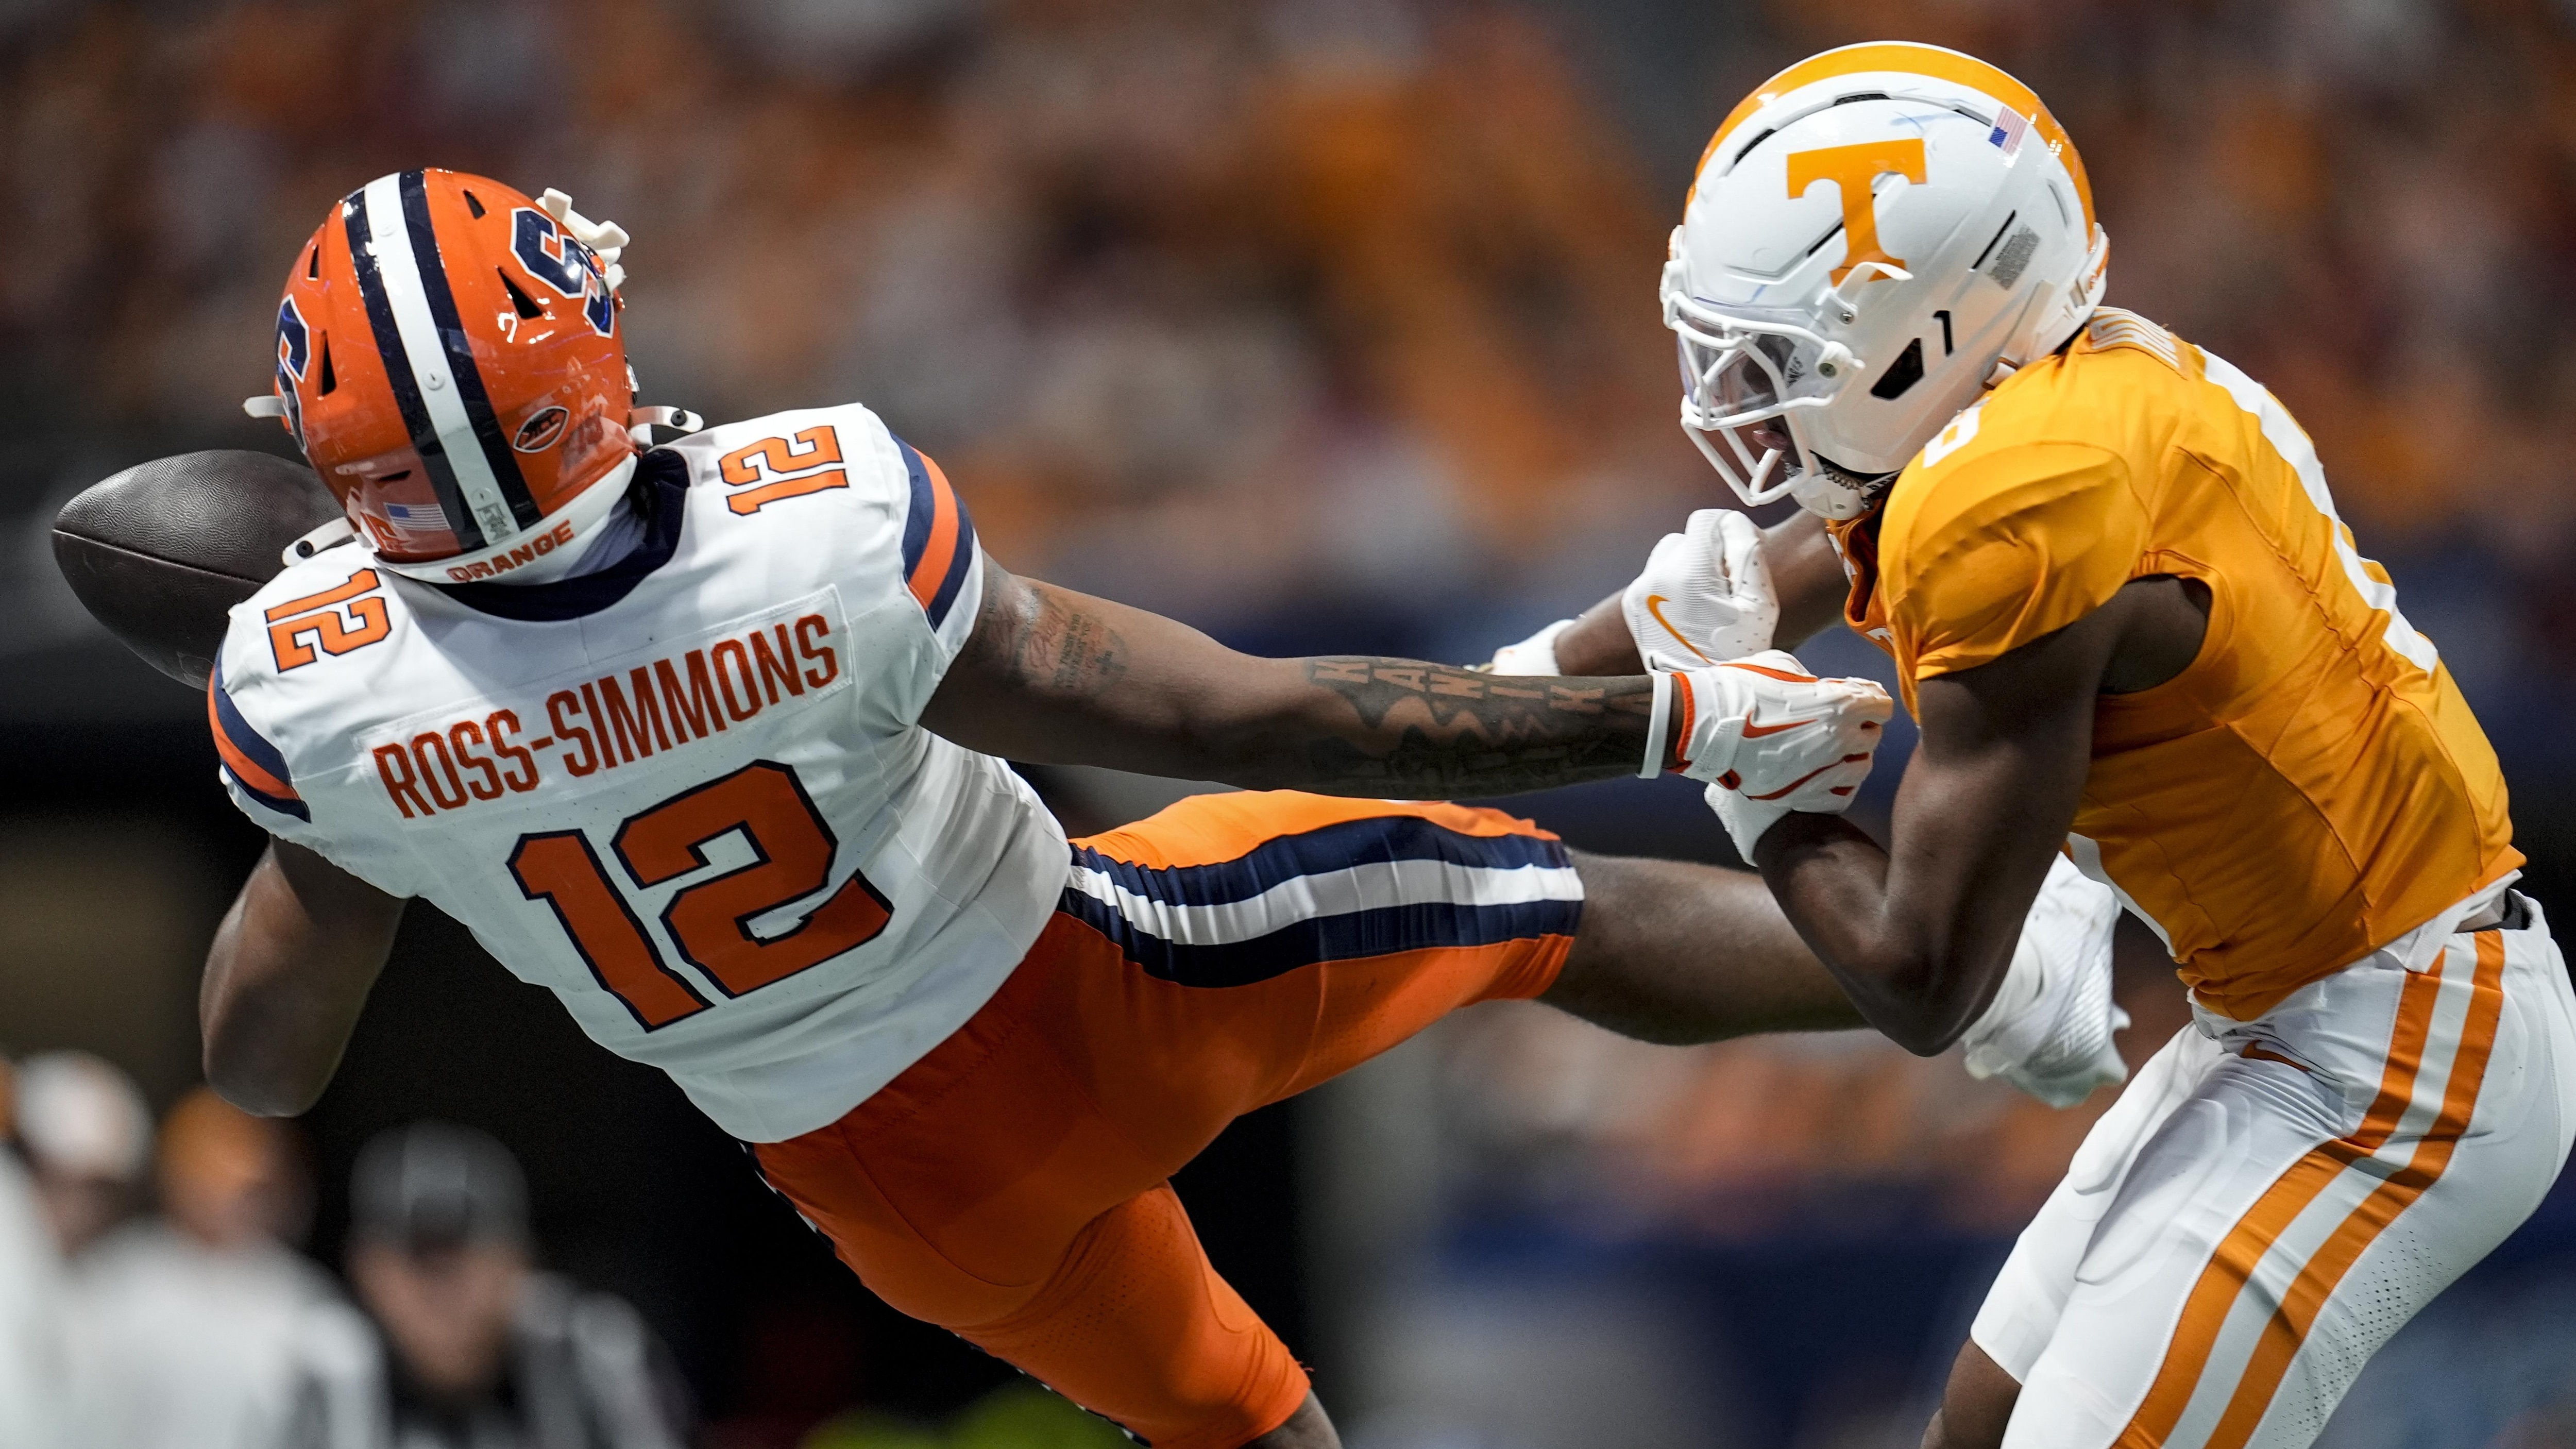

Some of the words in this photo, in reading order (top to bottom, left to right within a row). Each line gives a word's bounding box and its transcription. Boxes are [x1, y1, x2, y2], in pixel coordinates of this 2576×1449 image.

[510, 207, 614, 338] S
[1787, 138, 1927, 288] T
[719, 426, 850, 516] 12
[446, 520, 574, 583] ORANGE
[264, 568, 392, 673] 12
[373, 615, 839, 818] ROSS-SIMMONS
[506, 759, 894, 1033] 12
